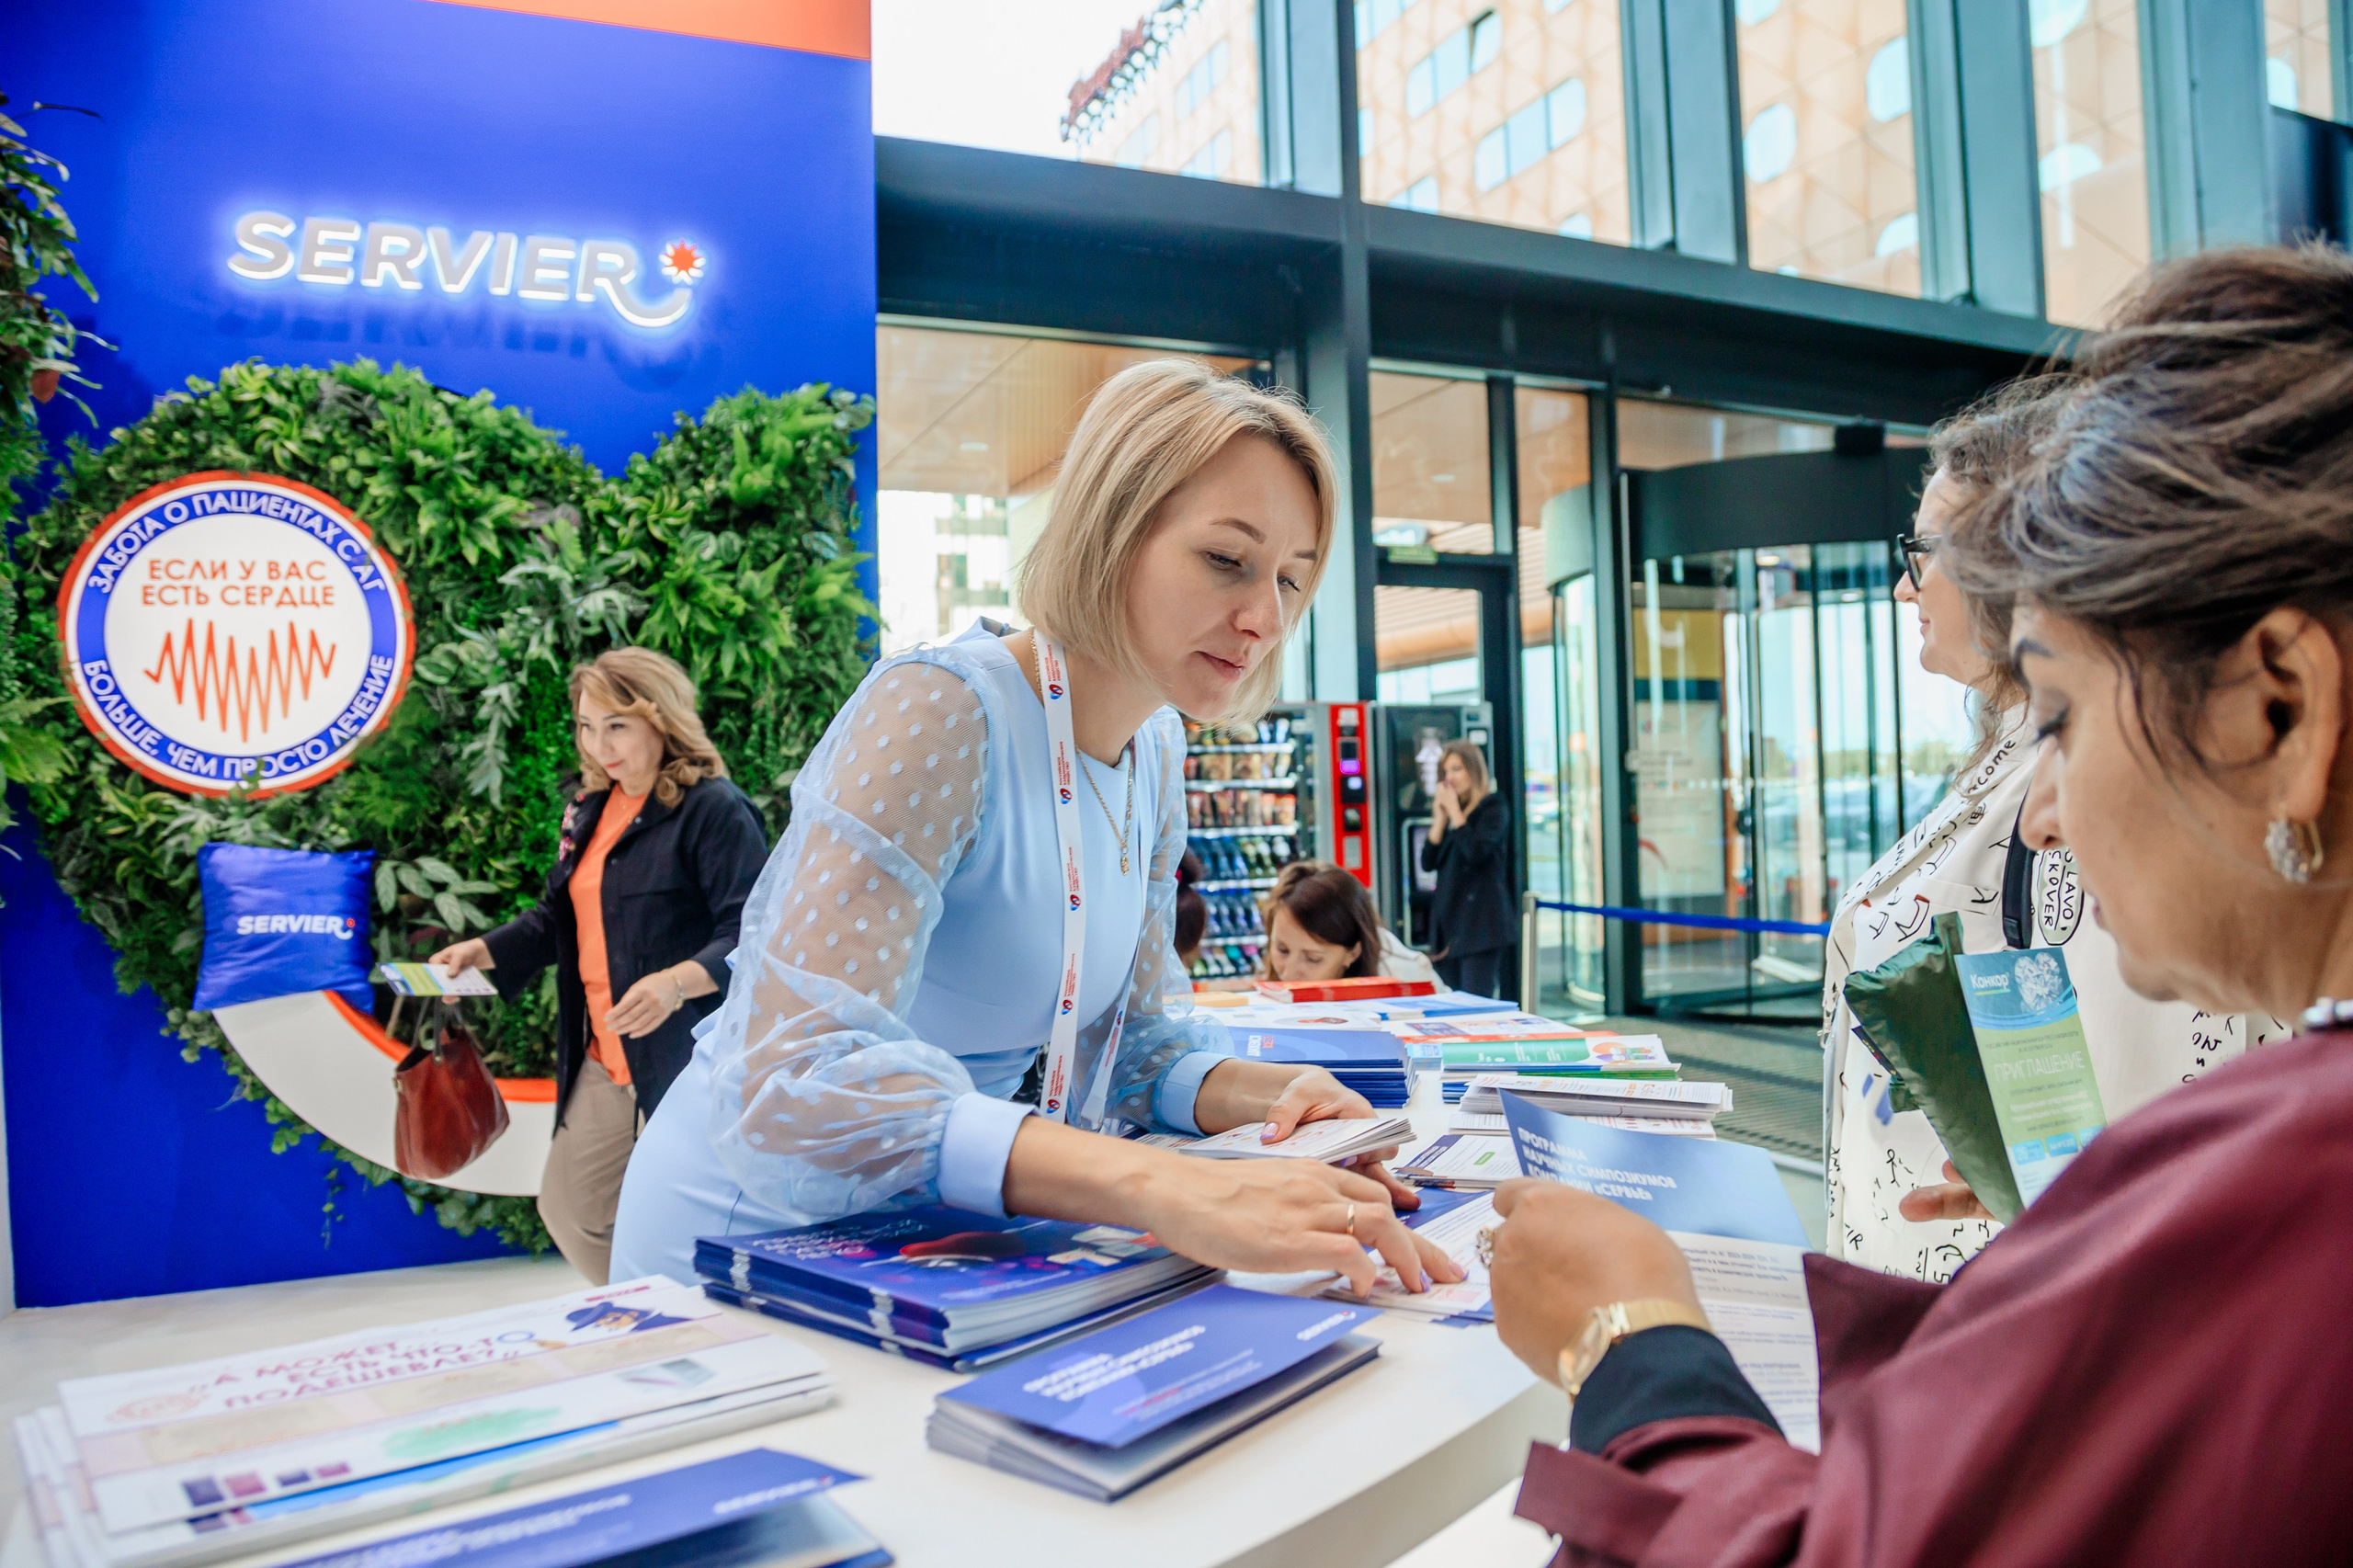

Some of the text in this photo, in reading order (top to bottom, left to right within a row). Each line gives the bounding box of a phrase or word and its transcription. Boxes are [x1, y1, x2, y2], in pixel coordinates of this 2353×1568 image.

[228, 211, 692, 327] SERVIER
[89, 491, 386, 594] ЗАБОТА О ПАЦИЕНТАХ С АГ
[148, 559, 326, 581] ЕСЛИ У ВАС
[142, 585, 335, 608] ЕСТЬ СЕРДЦЕ
[83, 653, 392, 779] БОЛЬШЕ, ЧЕМ ПРОСТО ЛЕЧЕНИЕ
[236, 915, 354, 940] SERVIER
[1994, 1051, 2086, 1082] ПРИГЛАШЕНИЕ
[1518, 1126, 1588, 1162] ПРОГРАММА
[1576, 1164, 1677, 1189] СИМПОЗИУМОВ
